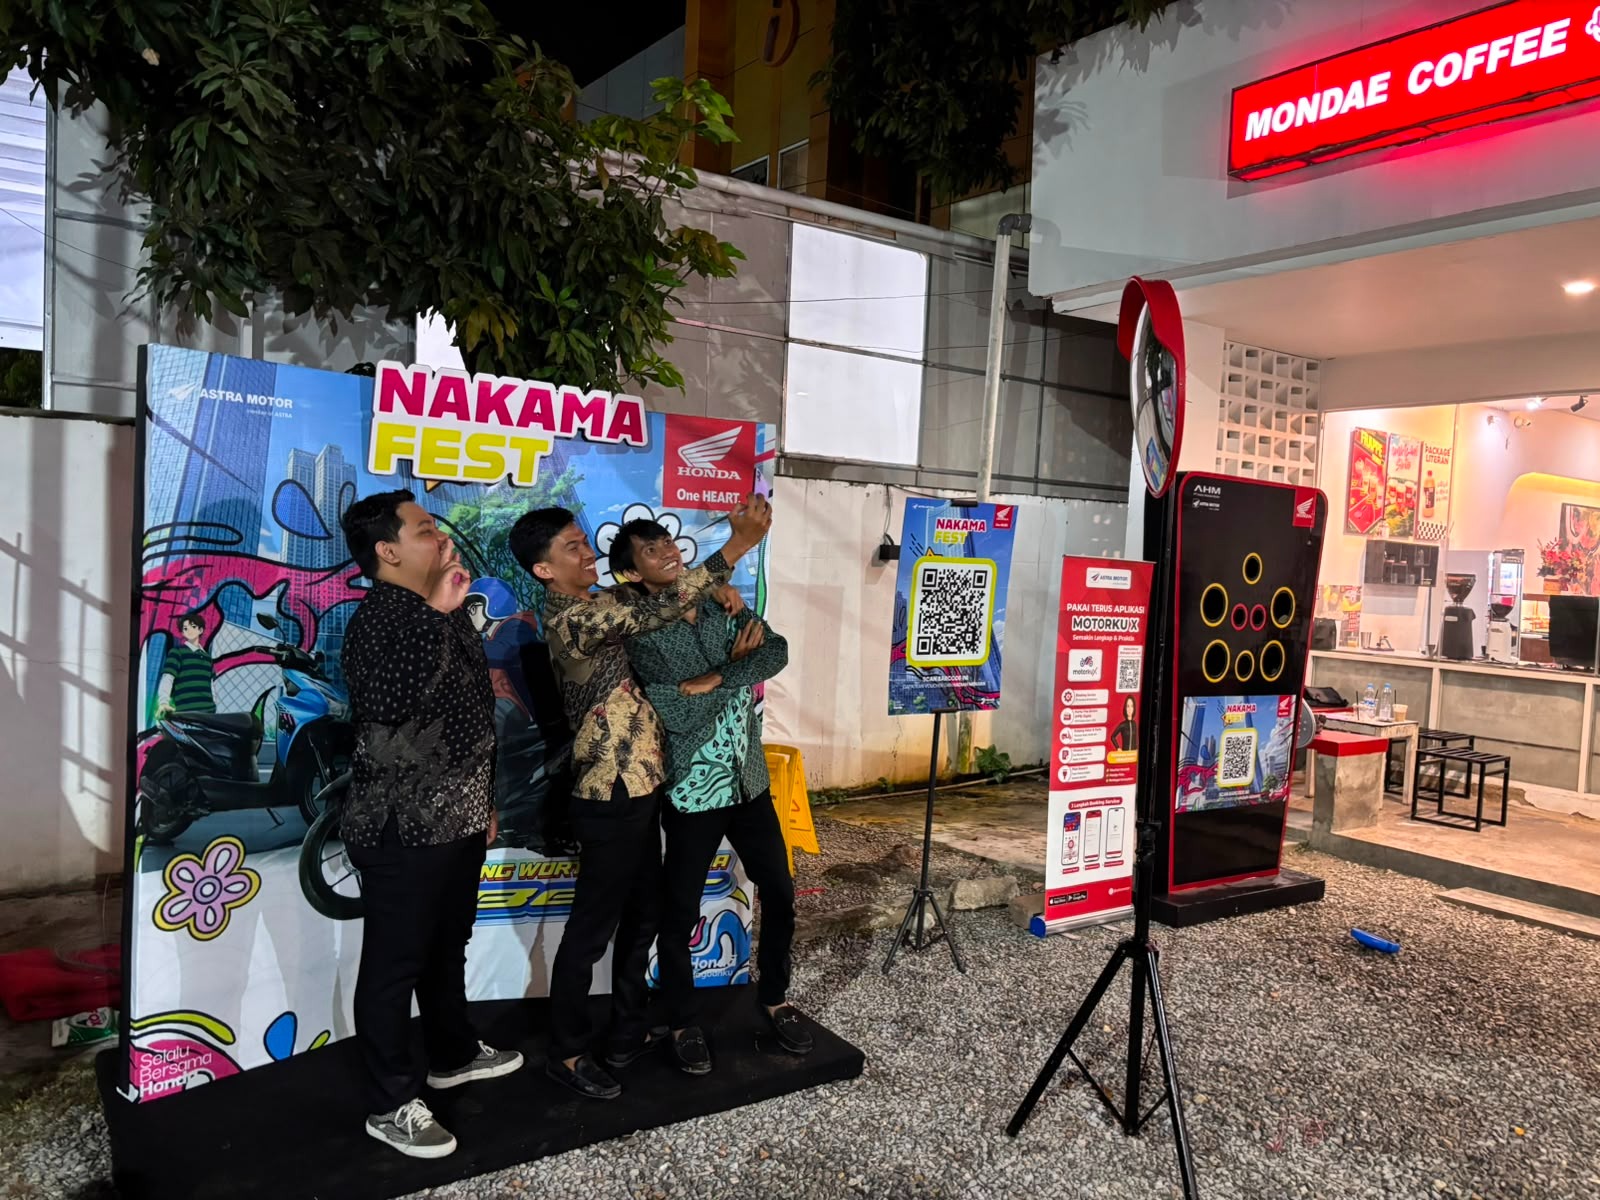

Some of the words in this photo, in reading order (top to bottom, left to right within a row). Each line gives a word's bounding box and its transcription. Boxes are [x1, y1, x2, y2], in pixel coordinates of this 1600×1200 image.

[1244, 71, 1391, 142] MONDAE
[1407, 17, 1571, 95] COFFEE
[200, 388, 244, 403] ASTRA
[246, 393, 293, 409] MOTOR
[378, 366, 644, 443] NAKAMA
[373, 421, 549, 484] FEST
[1425, 445, 1452, 457] PACKAGE
[1425, 455, 1449, 464] LITERAN
[677, 466, 742, 481] HONDA
[676, 488, 700, 501] One
[1194, 484, 1221, 495] AHM
[935, 518, 987, 533] NAKAMA
[934, 530, 968, 544] FEST
[1066, 603, 1090, 612] PAKAI
[1091, 604, 1112, 612] TERUS
[1114, 605, 1145, 614] APLIKASI
[1072, 617, 1128, 630] MOTORKU
[1226, 704, 1257, 713] NAKAMA
[479, 862, 516, 882] NG
[140, 1045, 190, 1069] Selalu
[139, 1053, 212, 1084] Bersama
